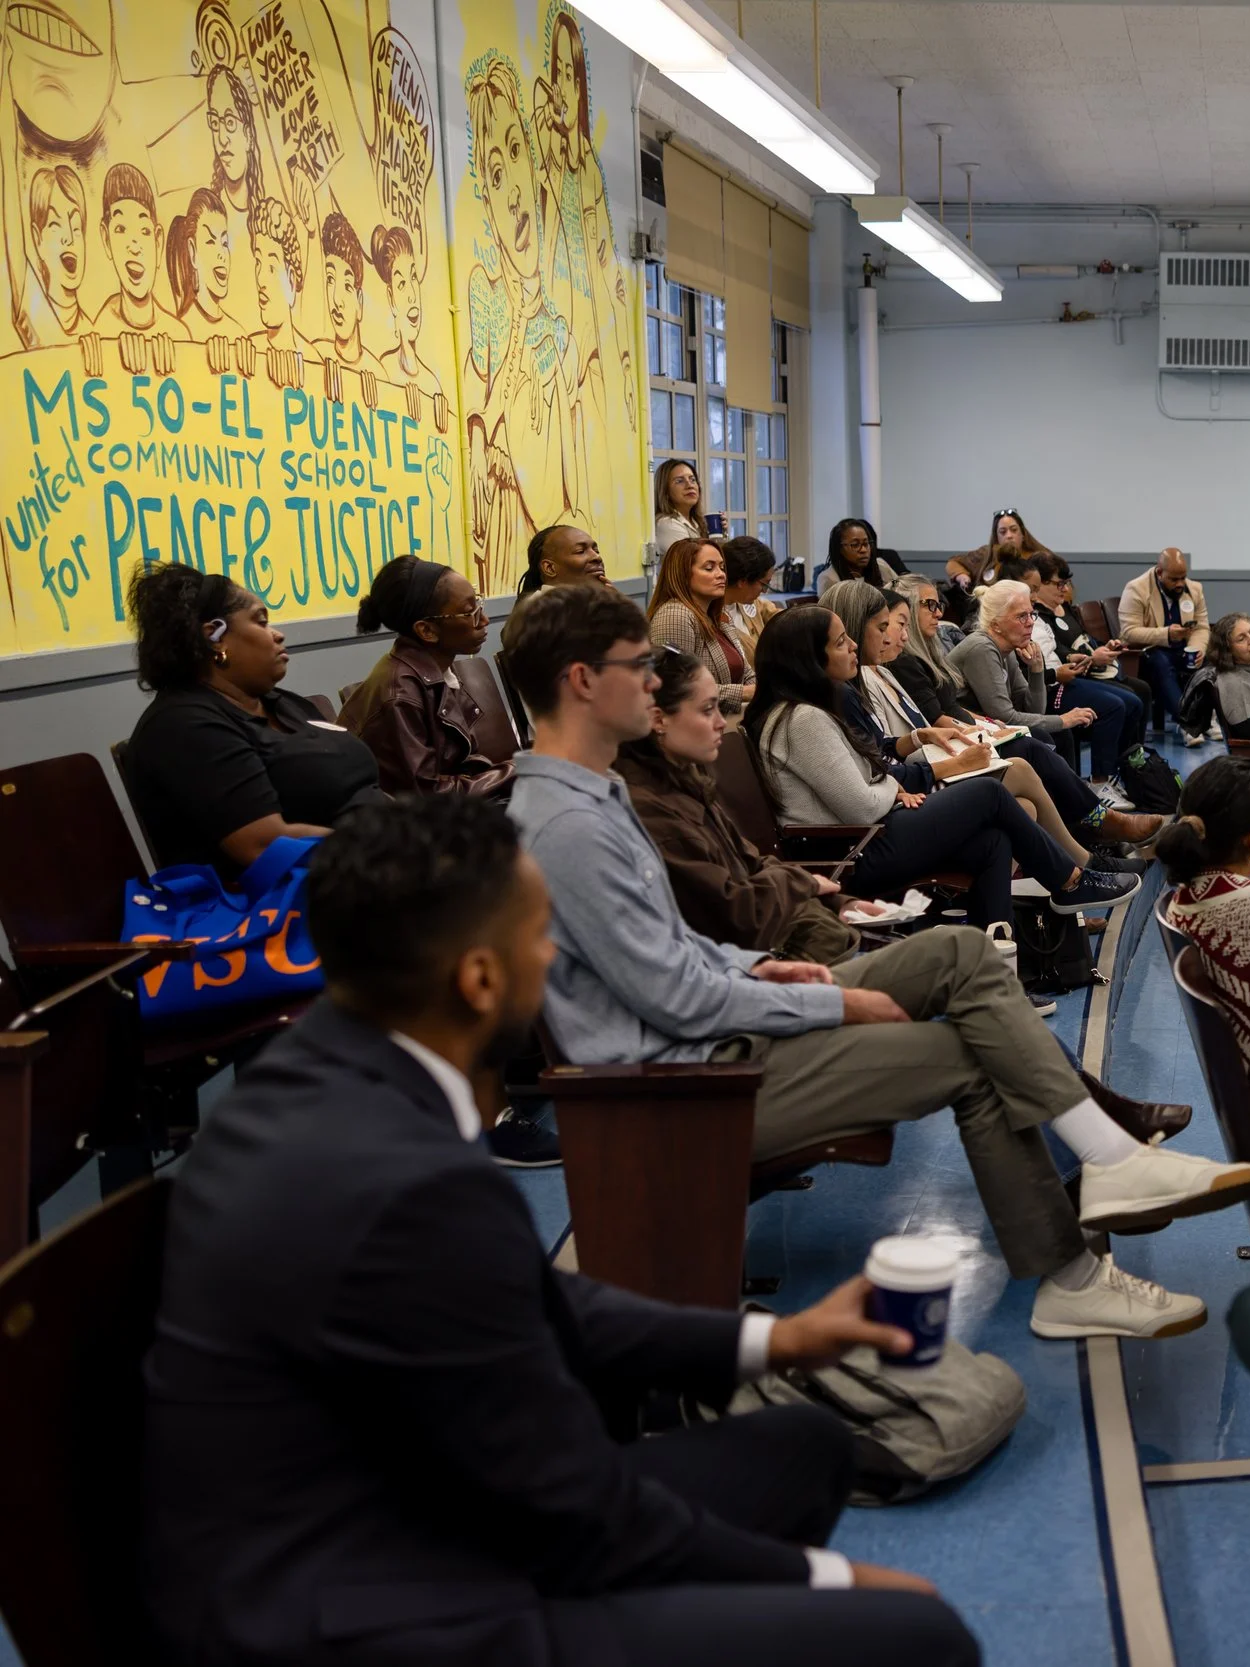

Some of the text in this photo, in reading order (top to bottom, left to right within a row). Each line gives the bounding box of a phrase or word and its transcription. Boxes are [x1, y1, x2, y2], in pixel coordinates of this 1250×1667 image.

[247, 1, 284, 59] LOVE
[256, 29, 297, 83] YOUR
[262, 51, 316, 119] MOTHER
[281, 85, 319, 145] LOVE
[376, 35, 429, 156] DEFIENDA
[286, 121, 340, 183] EARTH
[293, 115, 322, 152] YOUR
[382, 116, 423, 206] MADRE
[387, 79, 426, 178] NUESTRA
[380, 159, 423, 256] TIERRA
[23, 368, 110, 445] MS
[284, 387, 422, 474] PUENTE
[6, 427, 85, 551] united
[87, 441, 387, 493] COMMUNITY SCHOOL
[39, 535, 91, 632] for
[103, 480, 237, 621] PEACE
[285, 496, 422, 605] JUSTICE
